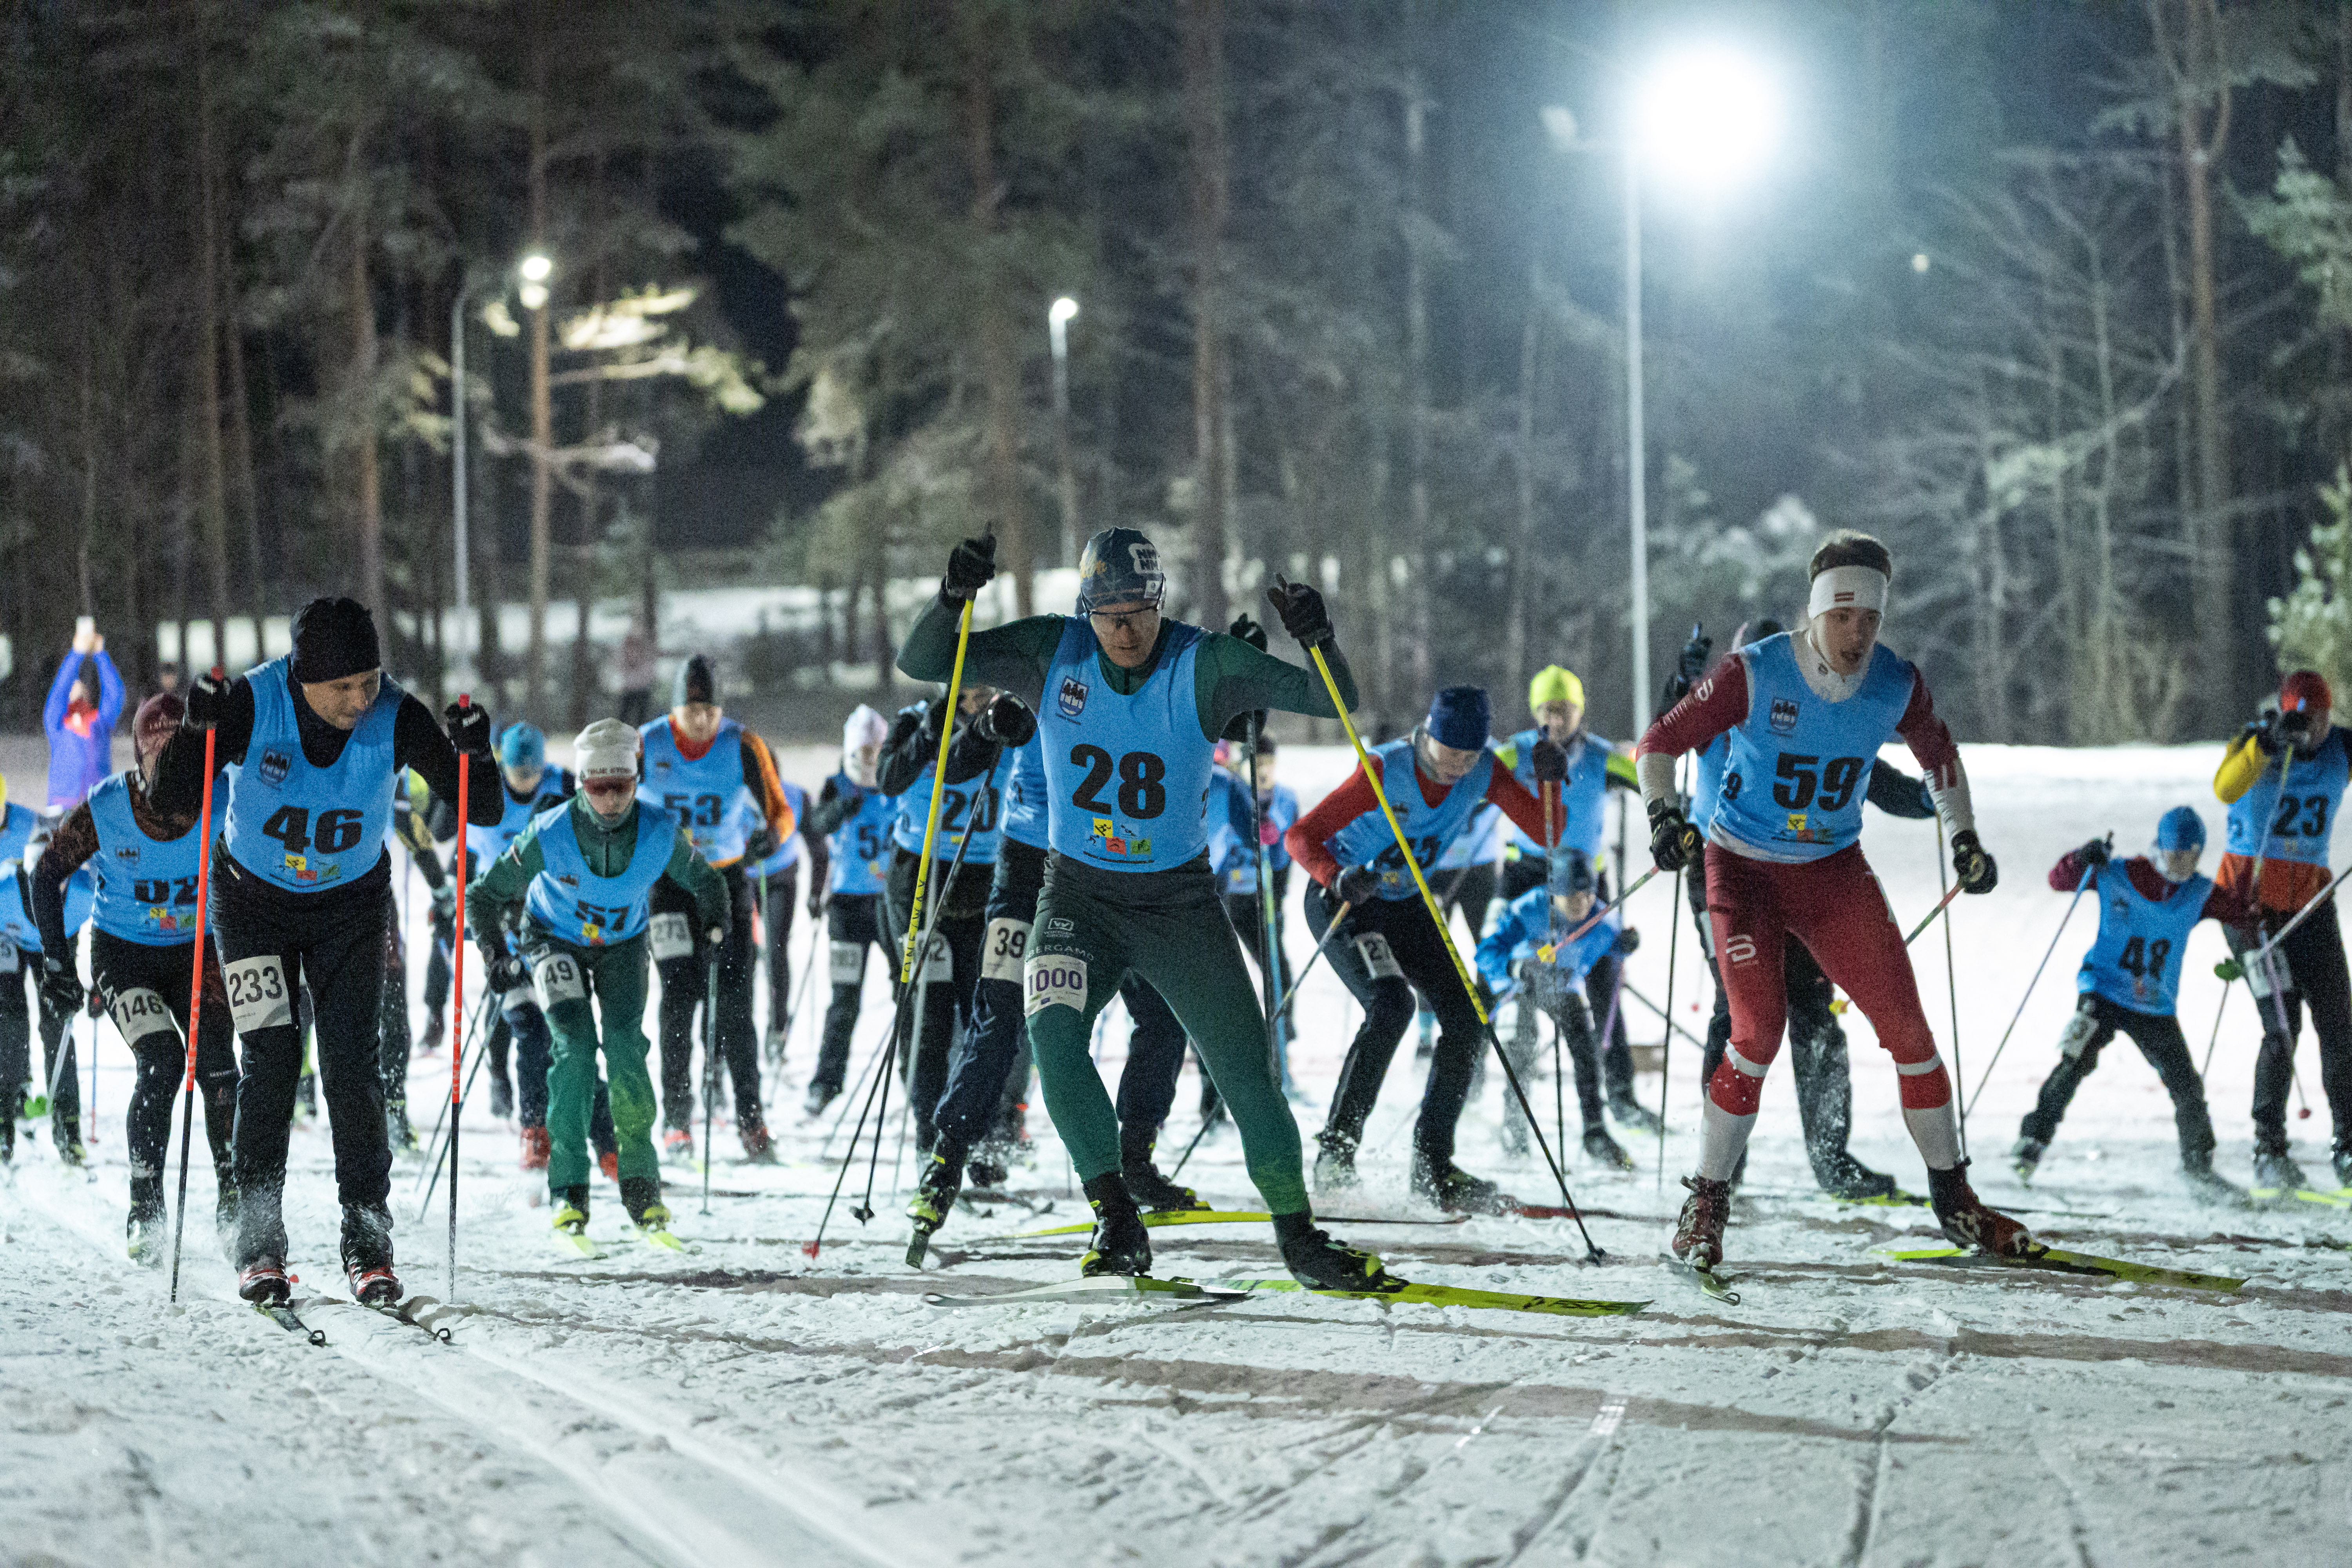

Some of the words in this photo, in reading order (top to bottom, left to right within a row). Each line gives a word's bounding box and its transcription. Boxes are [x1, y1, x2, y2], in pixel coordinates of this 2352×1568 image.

[1071, 743, 1166, 820] 28
[1724, 772, 1742, 800] 9
[1773, 751, 1865, 812] 59
[263, 804, 365, 855] 46
[664, 793, 722, 828] 53
[941, 786, 1000, 833] 20
[2272, 795, 2329, 838] 23
[575, 899, 630, 932] 57
[994, 927, 1026, 959] 39
[1028, 944, 1094, 961] BERGAMO
[2118, 935, 2171, 982] 48
[229, 965, 283, 1008] 233
[1029, 967, 1083, 996] 1000
